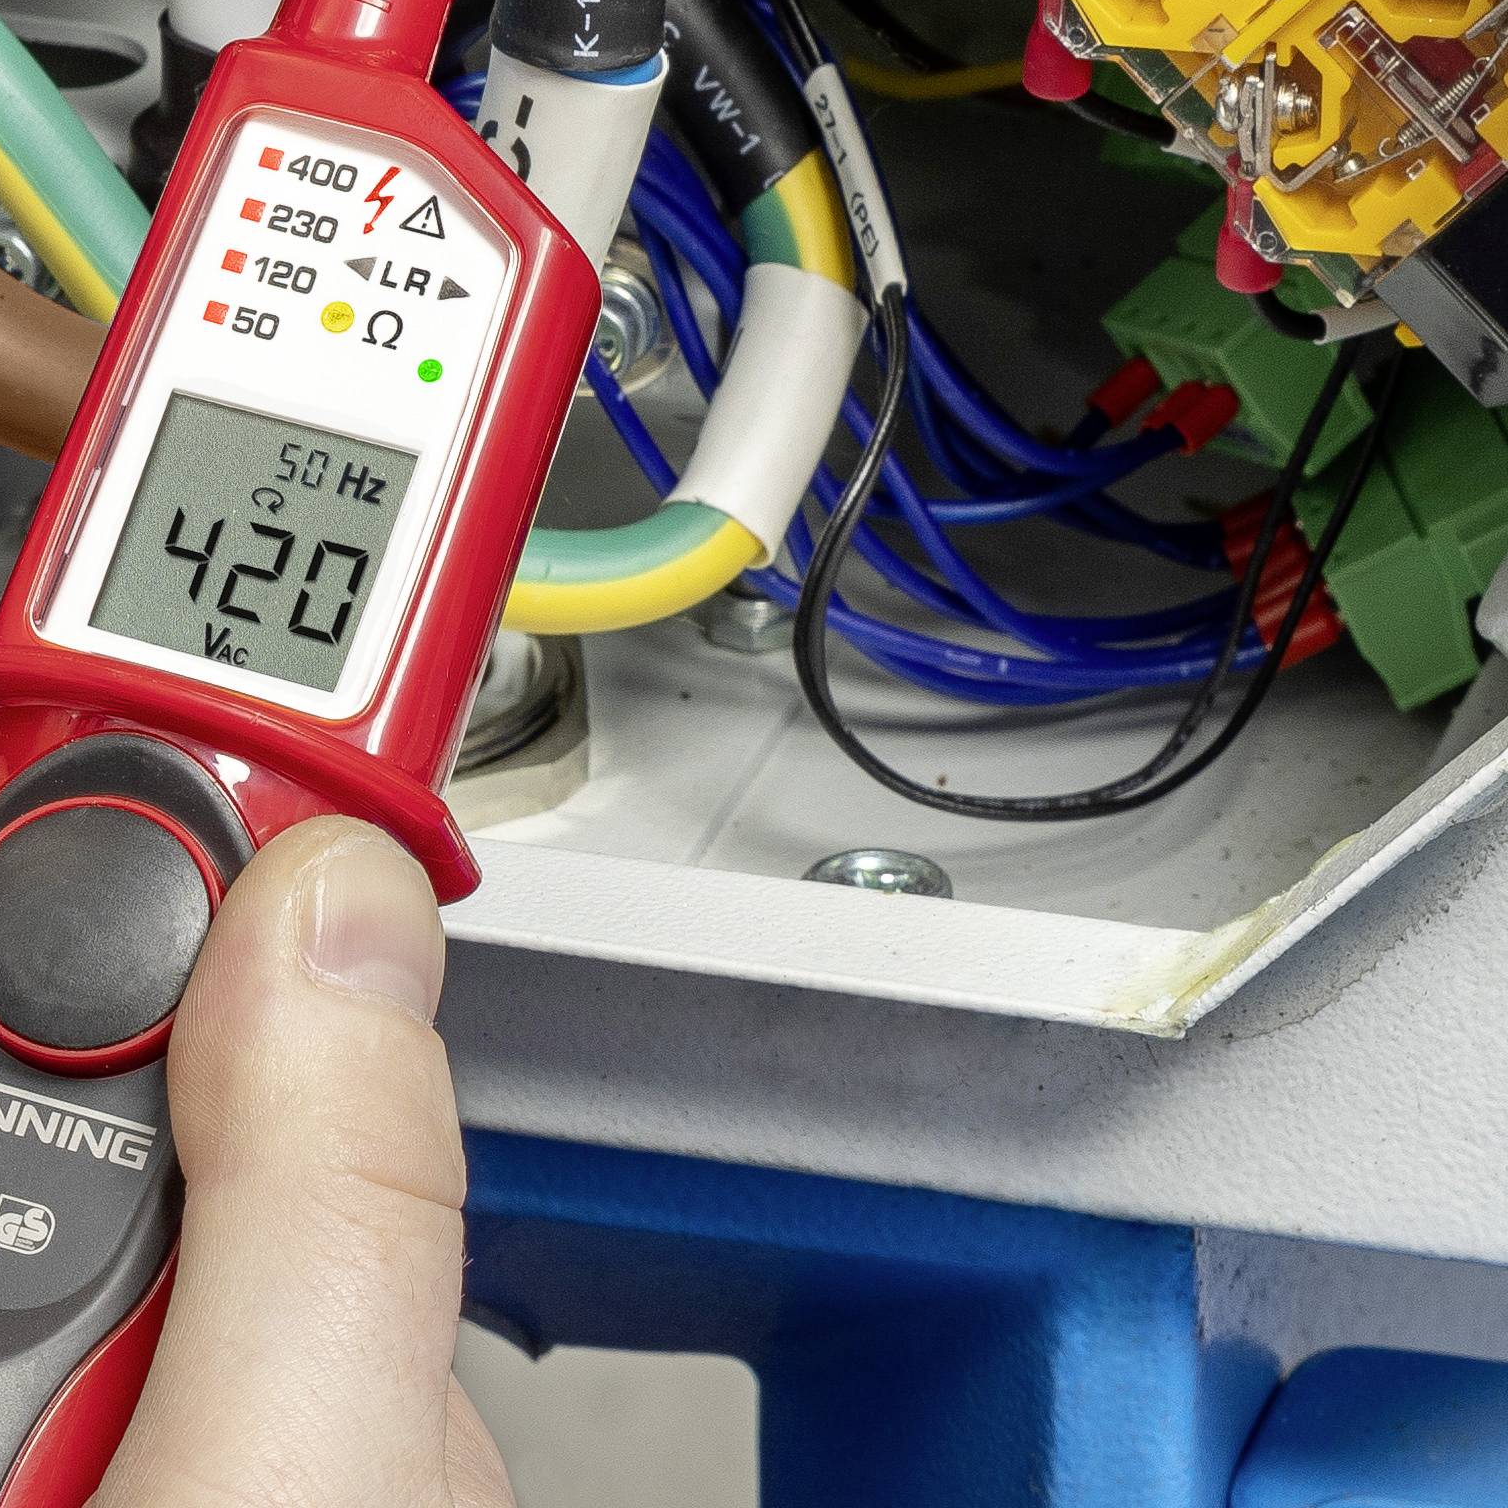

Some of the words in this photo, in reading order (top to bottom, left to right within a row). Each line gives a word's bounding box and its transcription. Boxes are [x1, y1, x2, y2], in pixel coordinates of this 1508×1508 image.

[694, 64, 762, 156] VW-1
[287, 154, 358, 193] 400
[267, 203, 339, 243] 230
[254, 255, 317, 294] 120
[231, 305, 280, 340] 50
[274, 442, 330, 488] 50
[336, 461, 387, 505] Hz
[164, 505, 369, 646] 420
